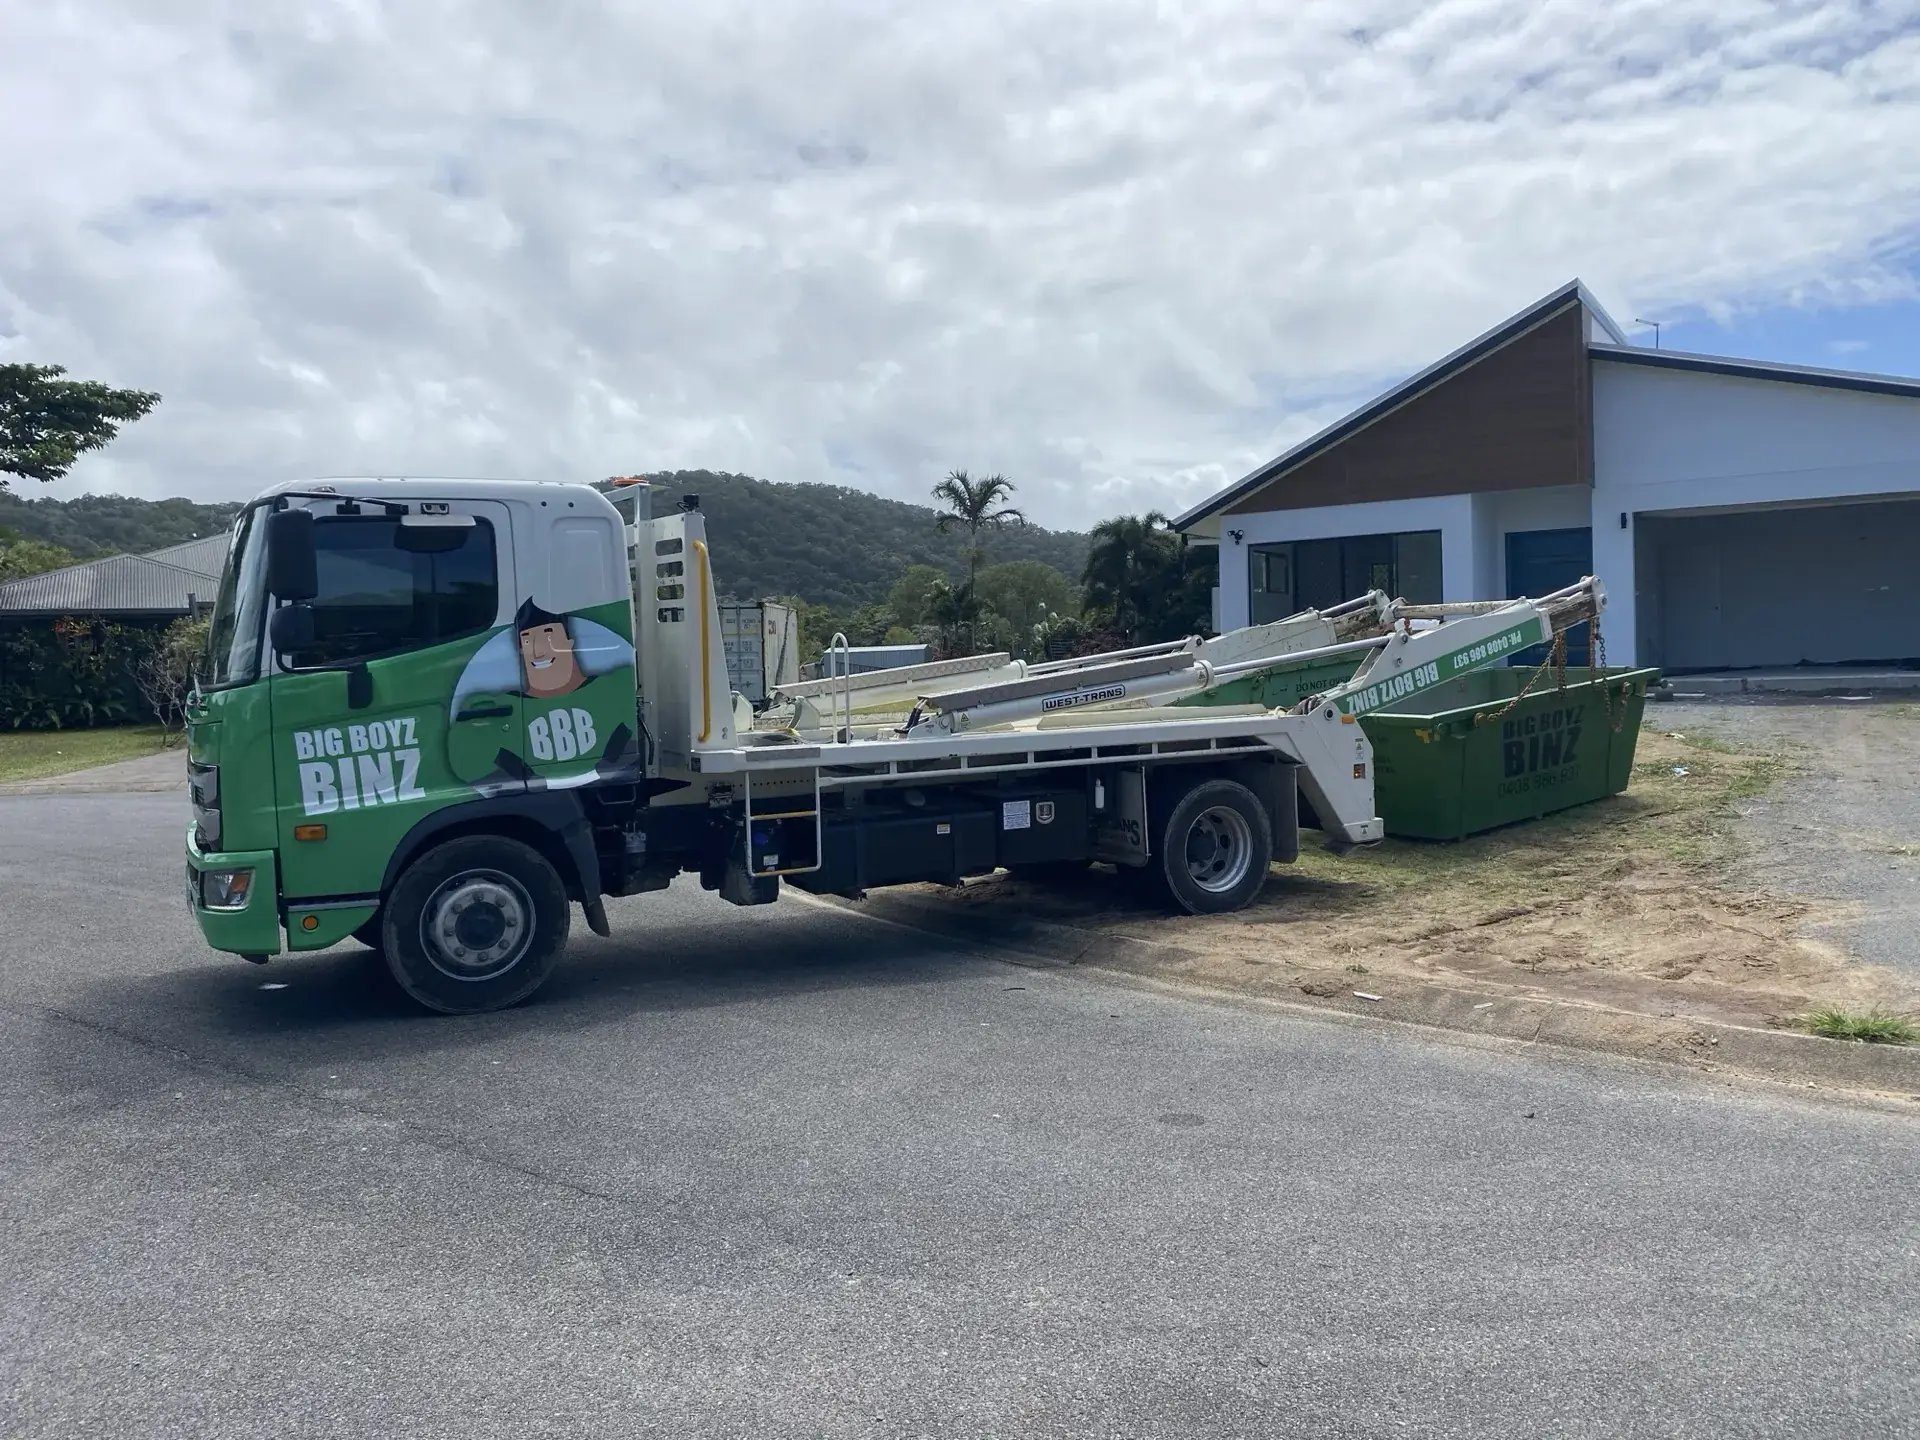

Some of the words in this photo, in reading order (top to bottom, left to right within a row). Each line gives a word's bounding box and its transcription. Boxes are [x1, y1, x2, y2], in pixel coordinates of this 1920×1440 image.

[1453, 650, 1470, 670] 937
[1471, 643, 1486, 663] 886
[1486, 636, 1509, 656] 0408
[1296, 681, 1309, 693] DO
[1310, 679, 1327, 691] NOT
[1416, 661, 1440, 686] BIG
[1045, 687, 1122, 709] WEST-TRANS
[1346, 684, 1380, 715] BINZ
[1379, 675, 1415, 704] BOYZ
[528, 707, 597, 762] BBB
[1502, 716, 1537, 740] BIG
[1540, 704, 1586, 733] BOYZ
[294, 727, 345, 760] BIG
[348, 717, 419, 753] BOYZ
[1503, 725, 1583, 779] BINZ
[298, 747, 426, 816] BINZ
